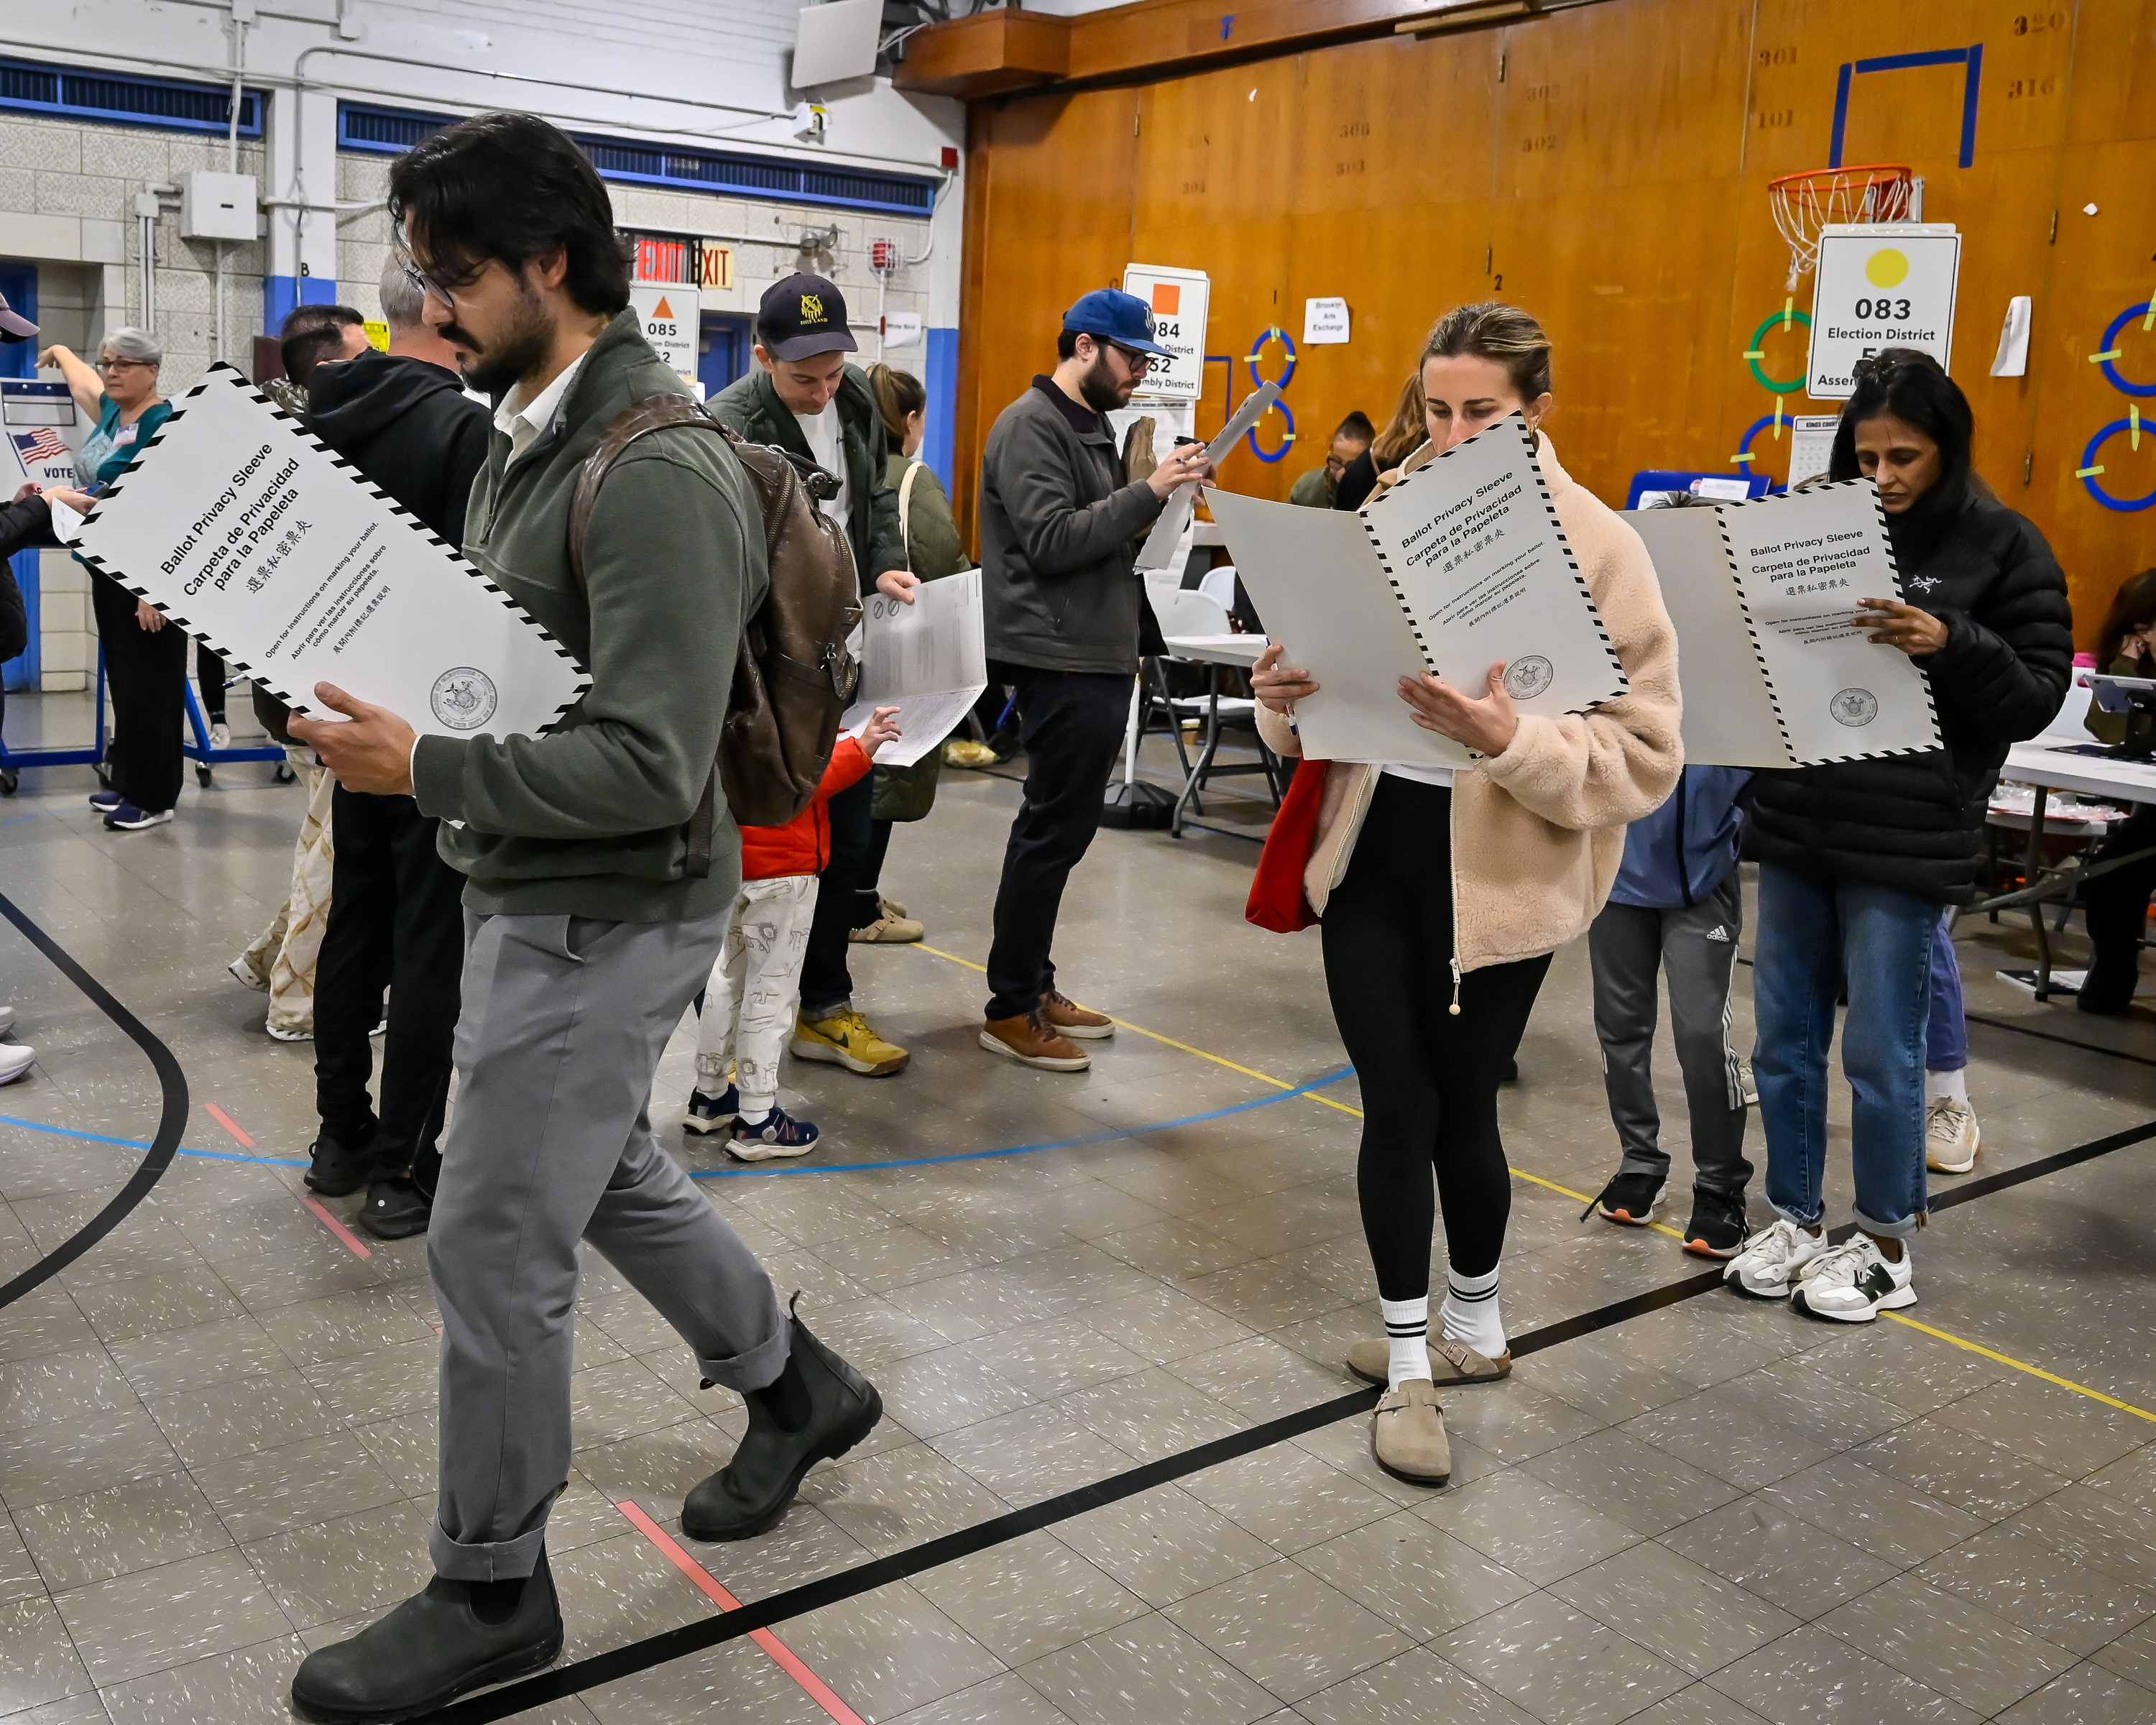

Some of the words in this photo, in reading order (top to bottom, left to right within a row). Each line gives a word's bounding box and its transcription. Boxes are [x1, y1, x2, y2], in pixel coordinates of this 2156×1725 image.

[300, 262, 310, 277] B
[638, 239, 684, 282] EXIT
[1494, 274, 1503, 291] 2
[1854, 298, 1912, 321] 083
[648, 323, 677, 336] 085
[1154, 321, 1180, 339] 84
[1827, 327, 1883, 341] Election
[1885, 328, 1935, 341] District
[1164, 344, 1194, 354] District
[1141, 377, 1163, 389] mbly
[1165, 379, 1194, 390] District
[44, 467, 74, 479] VOTE
[160, 535, 198, 576] Ballot
[191, 486, 237, 536] Privacy
[231, 444, 272, 487] Sleeve
[183, 545, 230, 596] Carpeta
[226, 527, 244, 545] de
[239, 457, 300, 526] Privacidad
[1401, 522, 1433, 549] Ballot
[1433, 495, 1473, 526] Privacy
[1475, 472, 1513, 497] Sleeve
[1406, 535, 1447, 566] Carpeta
[1449, 524, 1463, 536] de
[1464, 484, 1522, 526] Privacidad
[213, 558, 242, 592] para
[236, 544, 254, 558] la
[247, 489, 299, 544] Papeleta
[1425, 546, 1450, 568] para
[1450, 538, 1462, 548] la
[1462, 506, 1510, 540] Papeleta
[1750, 544, 1782, 557] Ballot
[1783, 538, 1823, 551] Privacy
[1826, 530, 1864, 543] Sleeve
[1751, 561, 1794, 574] Carpeta
[1796, 558, 1810, 566] de
[1812, 546, 1871, 564] Privacidad
[1769, 571, 1795, 584] para
[1796, 569, 1807, 577] la
[1808, 561, 1857, 575] Papeleta
[265, 640, 282, 658] Open
[279, 629, 290, 640] for
[287, 592, 321, 630] instructions
[319, 582, 328, 592] on
[326, 556, 351, 583] marking
[347, 540, 362, 558] your
[359, 522, 379, 542] ballot.
[1428, 608, 1443, 621] Open
[1451, 581, 1483, 604] instructions
[1491, 560, 1514, 577] marking
[1514, 551, 1526, 564] your
[1526, 541, 1545, 554] ballot.
[1442, 614, 1455, 626] Abrir
[1456, 605, 1469, 617] para
[1486, 569, 1524, 594] instrucciones
[1524, 558, 1540, 571] sobre
[1459, 607, 1474, 620] cómo
[1474, 594, 1493, 610] marcar
[1501, 574, 1526, 592] papeleta.
[291, 642, 306, 661] Abrir
[305, 627, 319, 644] para
[316, 615, 328, 627] ver
[324, 605, 336, 617] las
[333, 564, 371, 607] instrucciones
[369, 545, 387, 564] sobre
[313, 628, 329, 647] cómo
[327, 605, 347, 629] marcar
[346, 596, 355, 606] su
[353, 569, 379, 598] papeleta.
[1706, 934, 1730, 943] adidas
